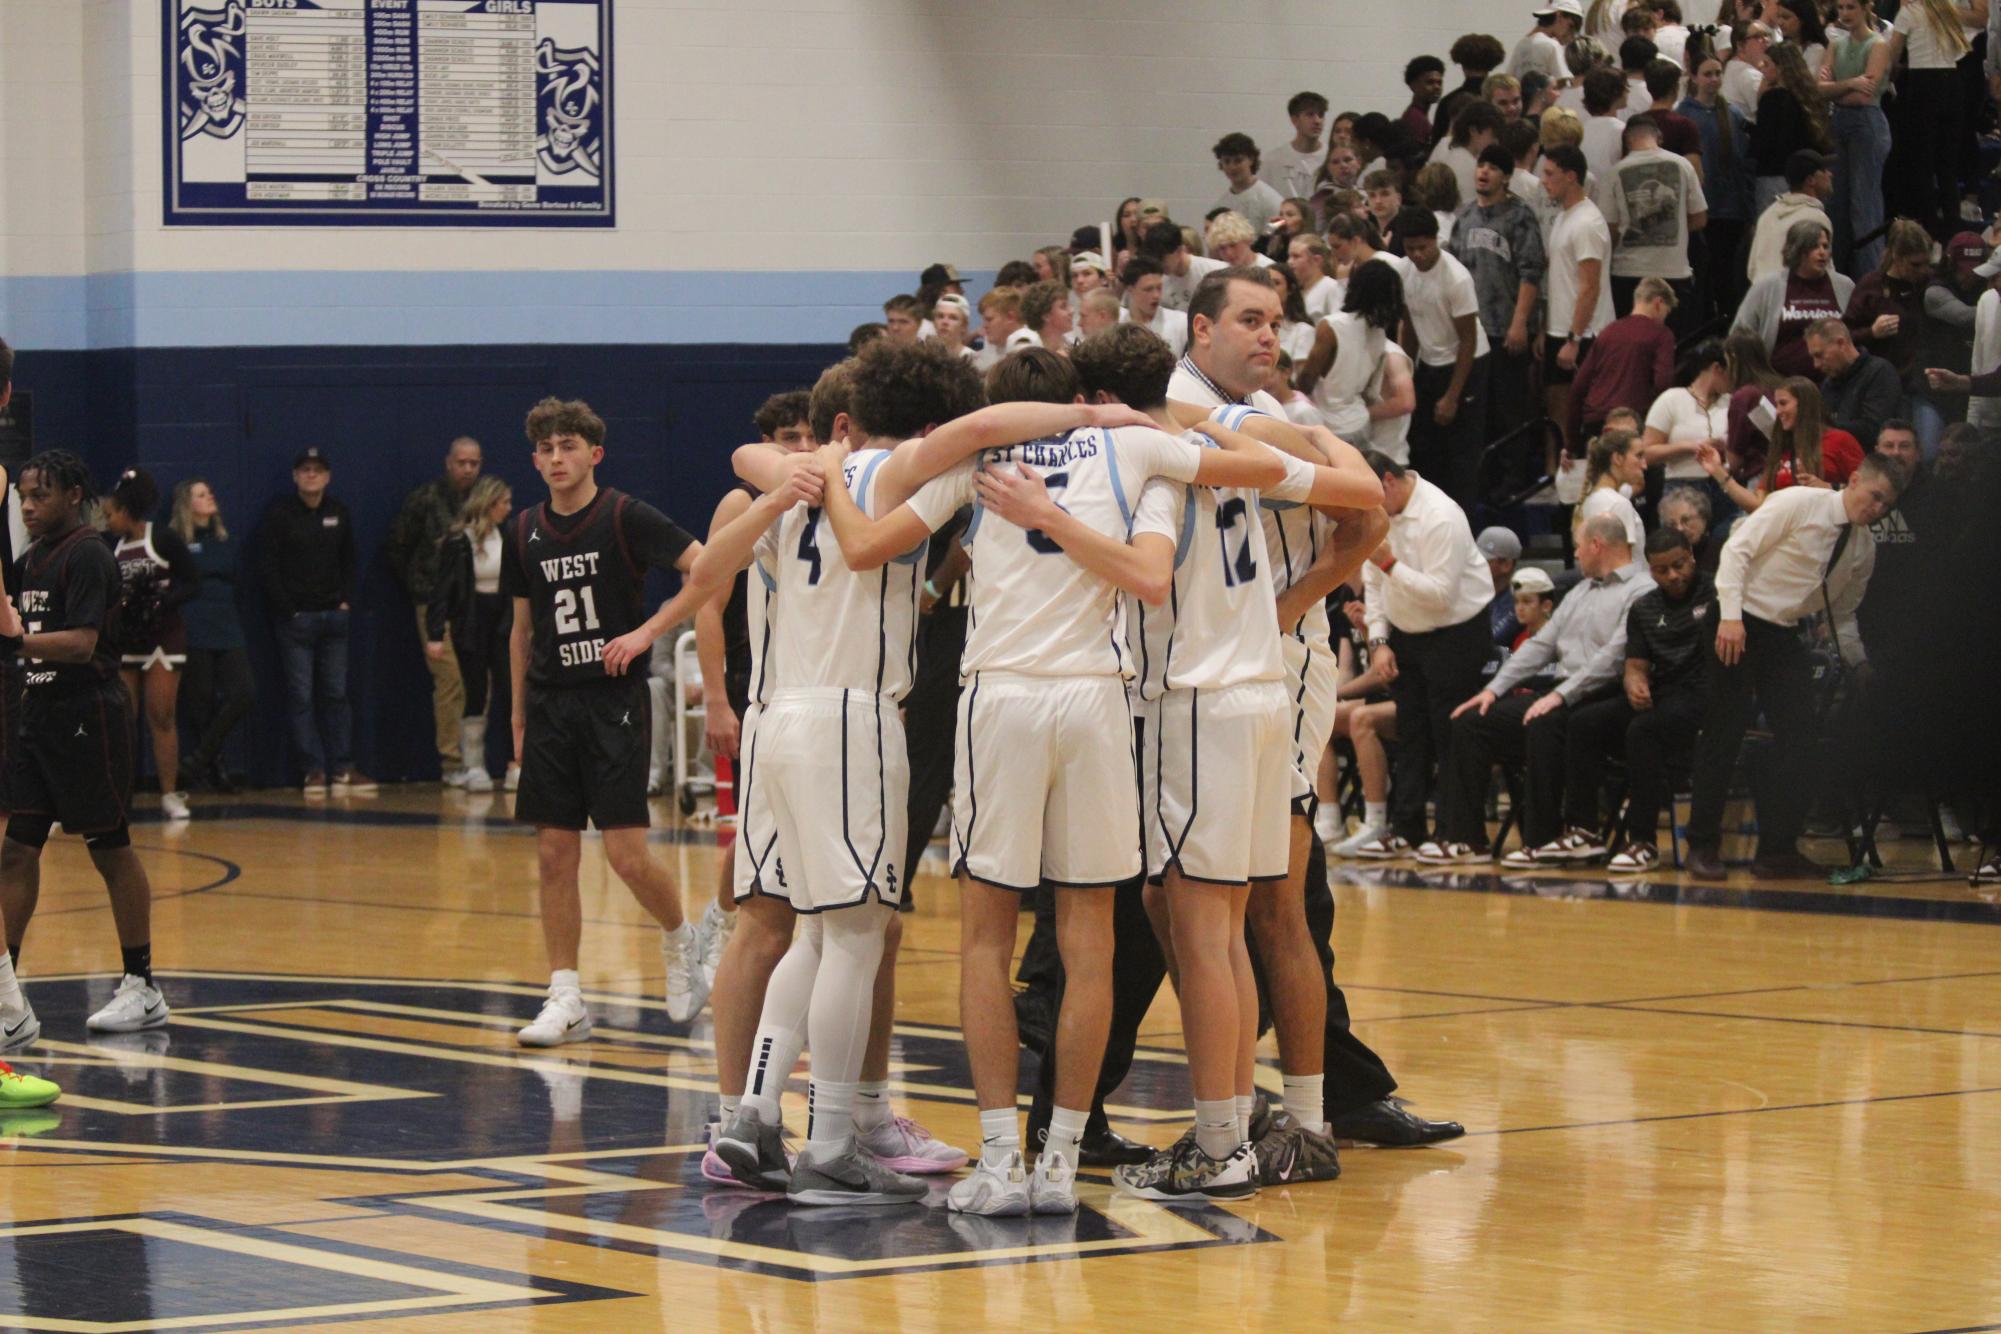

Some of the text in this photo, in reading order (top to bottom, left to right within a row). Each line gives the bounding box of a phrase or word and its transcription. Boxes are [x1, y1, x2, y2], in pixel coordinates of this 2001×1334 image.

[251, 0, 298, 8] BOYS
[371, 0, 408, 9] EVENT
[485, 0, 533, 13] GIRLS
[356, 174, 427, 183] CROSS COUNTRY
[1782, 304, 1843, 322] Warriors
[797, 504, 822, 586] 4
[1216, 497, 1257, 587] 12
[540, 551, 599, 582] WEST
[554, 585, 600, 634] 21
[559, 638, 605, 667] SIDE
